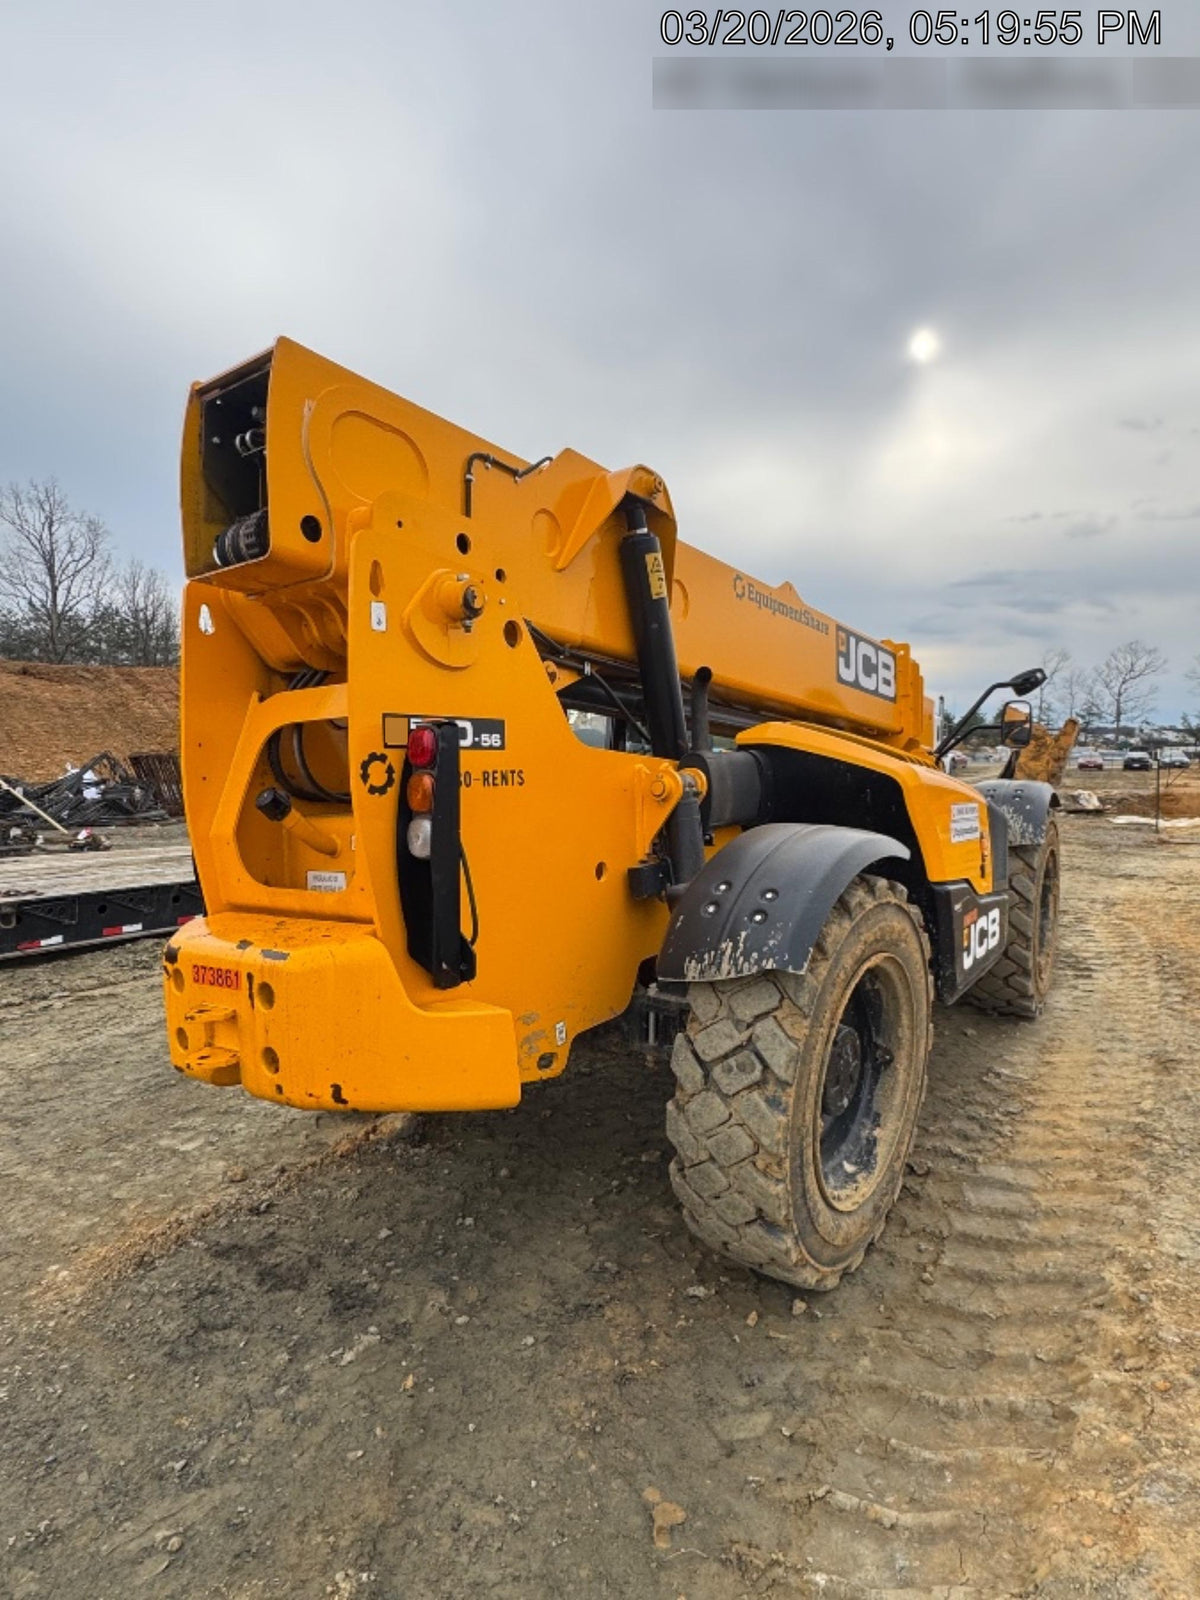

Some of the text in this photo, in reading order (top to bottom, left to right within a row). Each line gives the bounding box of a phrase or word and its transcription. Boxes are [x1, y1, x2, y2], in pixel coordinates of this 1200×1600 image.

[747, 582, 829, 636] EquipmentShare
[838, 635, 896, 699] JCB
[962, 907, 1000, 970] JCB
[192, 964, 241, 990] 373861
